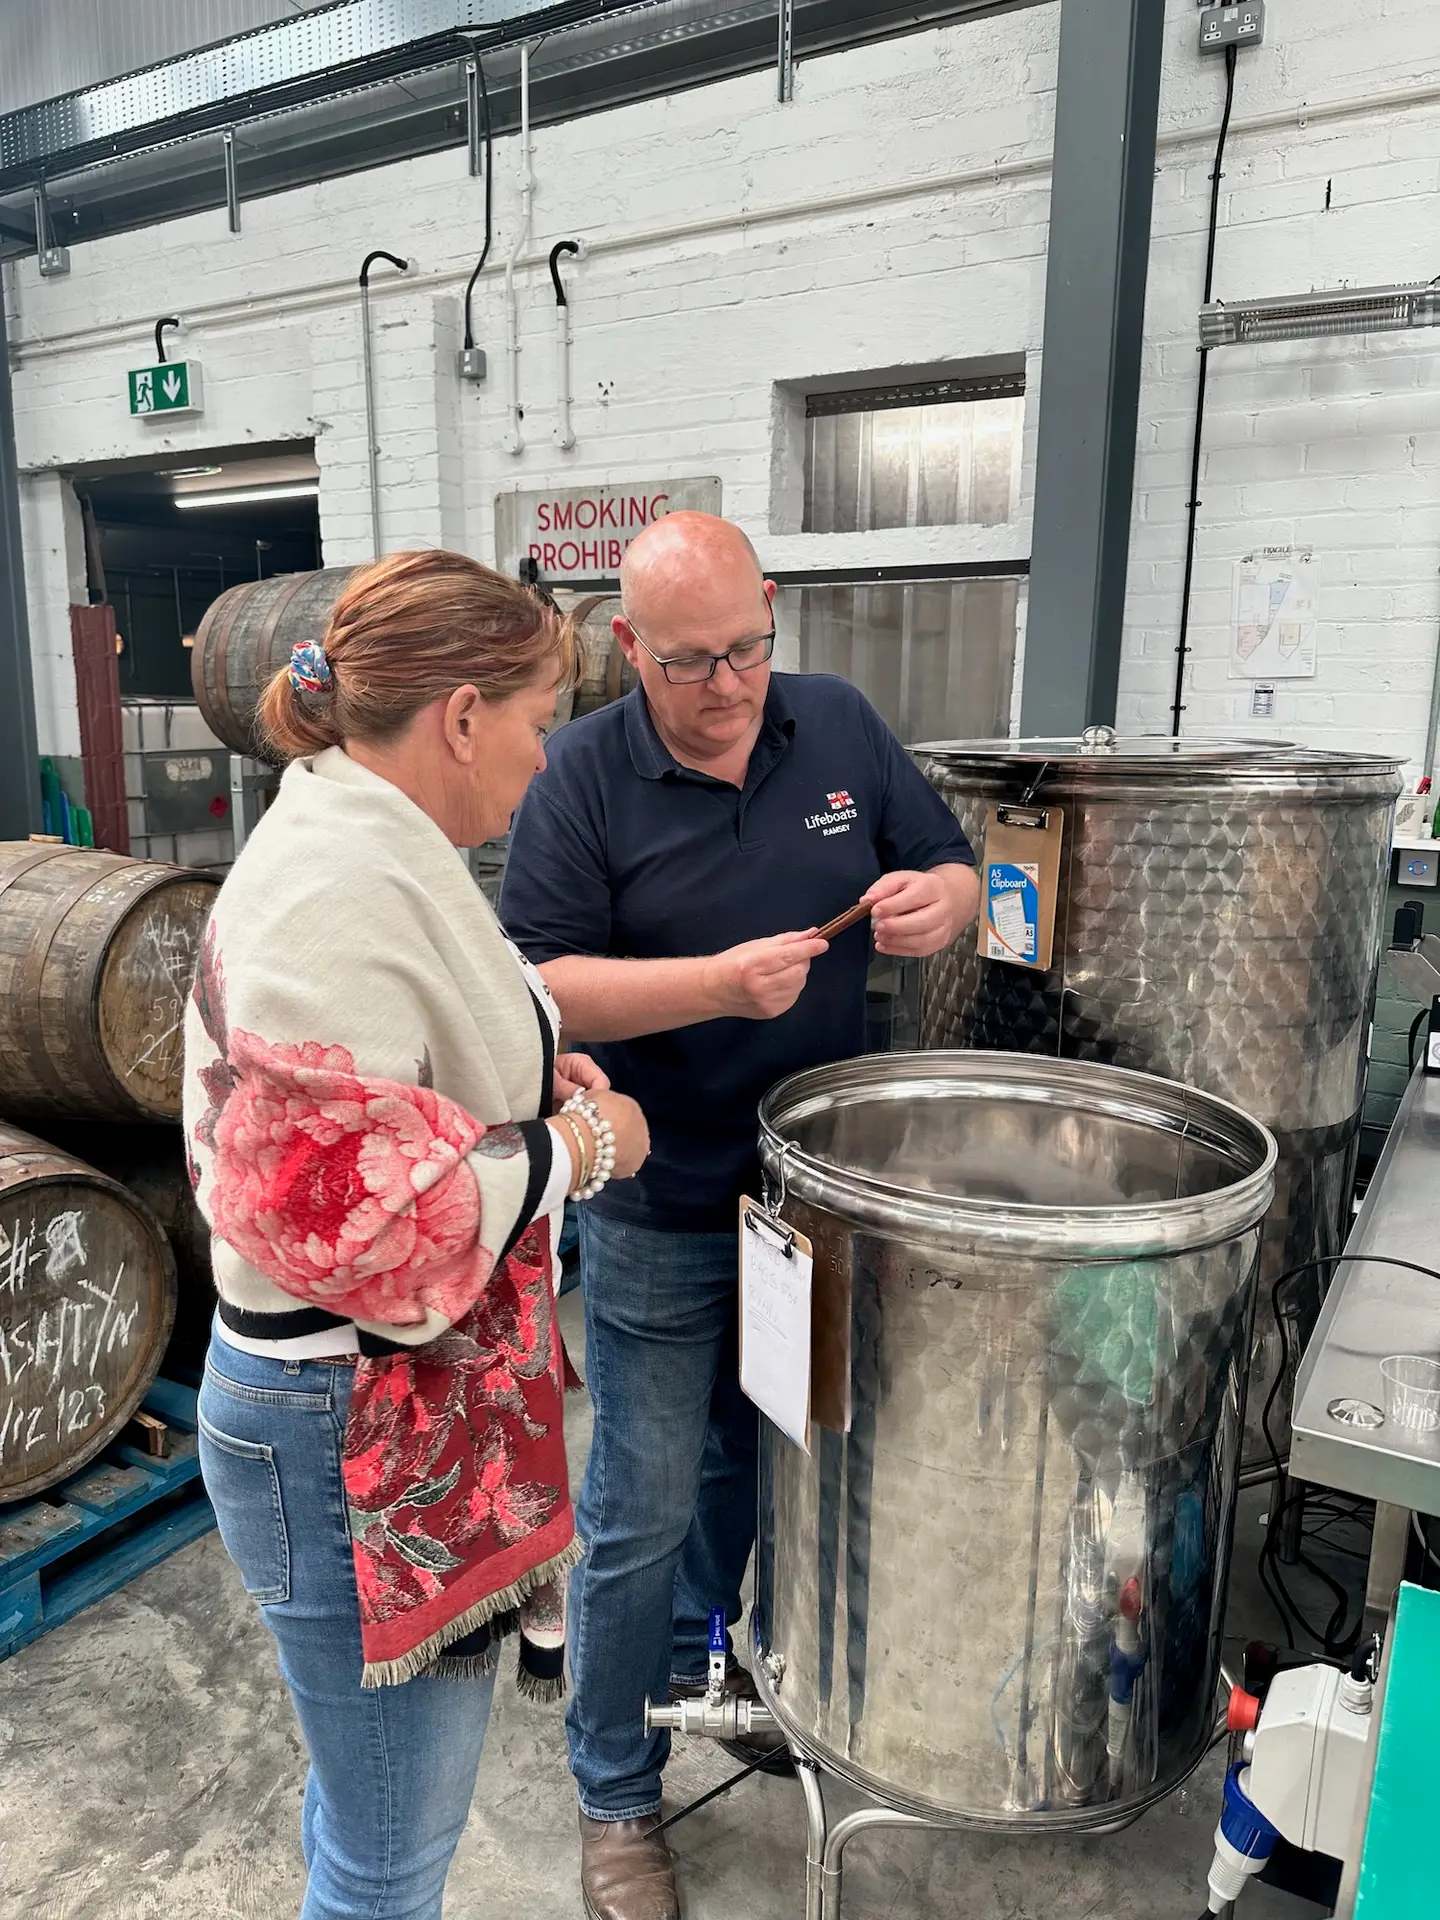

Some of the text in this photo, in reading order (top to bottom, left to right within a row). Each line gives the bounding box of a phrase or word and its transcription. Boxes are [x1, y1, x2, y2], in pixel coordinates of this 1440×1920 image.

[529, 539, 634, 571] PROHIB
[804, 808, 858, 829] Lifeboats
[823, 824, 851, 836] RAMSEY
[991, 868, 1002, 878] A5
[991, 878, 1027, 890] Clipboard
